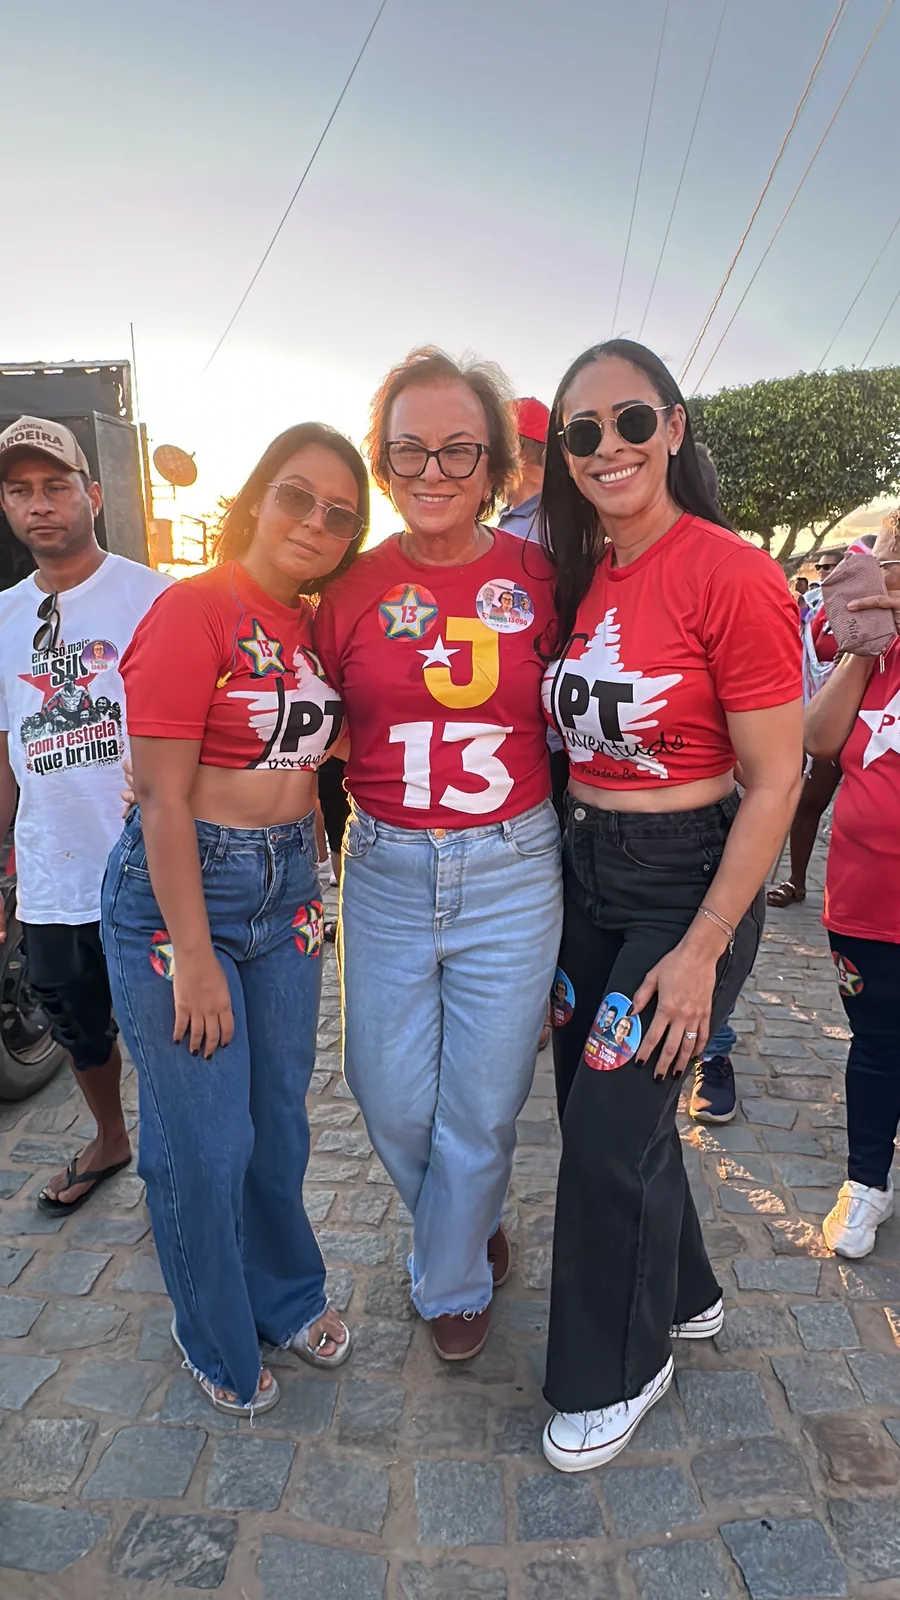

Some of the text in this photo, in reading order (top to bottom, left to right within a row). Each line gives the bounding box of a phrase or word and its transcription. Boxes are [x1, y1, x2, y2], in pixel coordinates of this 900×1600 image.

[11, 423, 43, 434] FAZENDA
[0, 430, 63, 449] AROEIRA
[400, 606, 418, 623] 13
[32, 650, 49, 663] era
[256, 640, 273, 658] 13
[32, 662, 49, 676] um
[424, 617, 499, 709] J
[559, 673, 633, 742] PT
[280, 701, 345, 752] PT
[877, 713, 900, 733] P
[28, 720, 116, 757] com a estrela
[34, 740, 118, 776] que brilha
[389, 721, 514, 814] 13
[309, 919, 320, 938] 13
